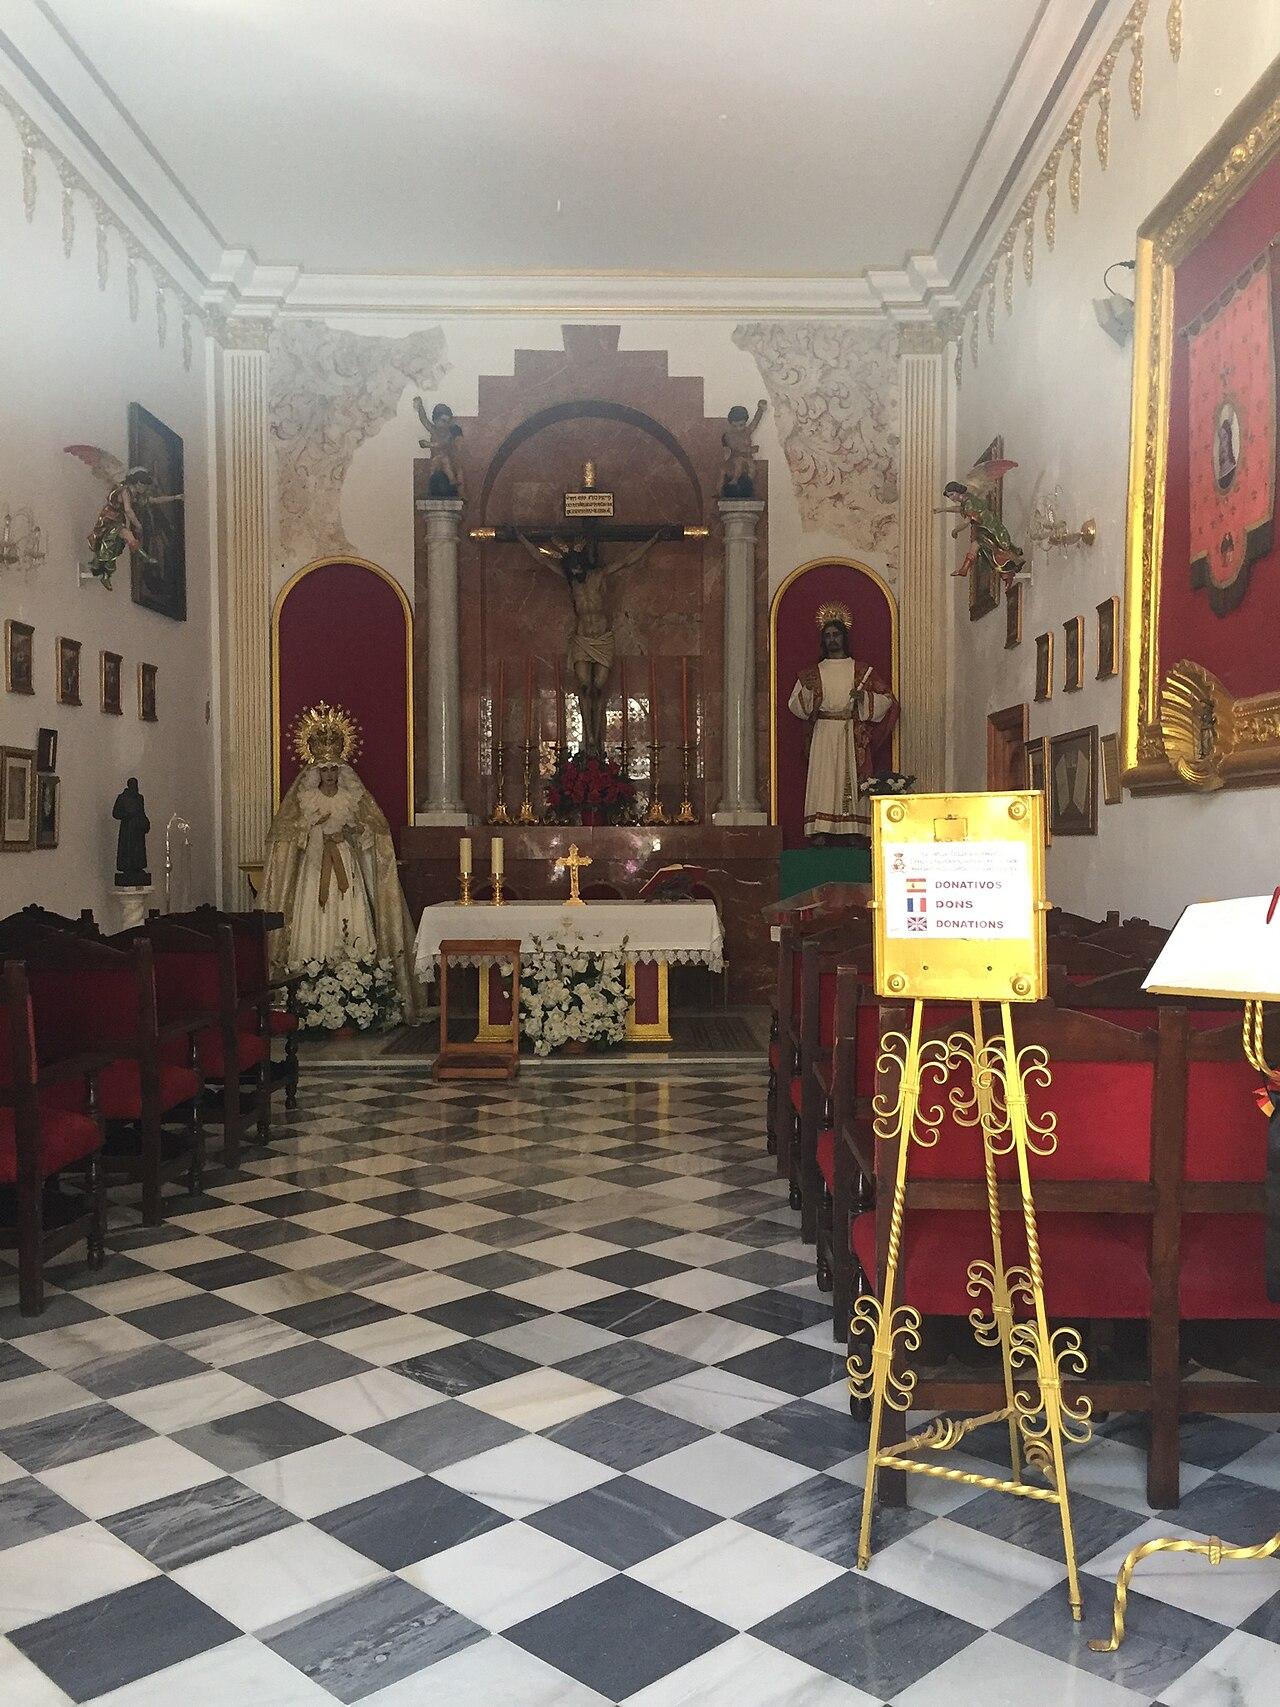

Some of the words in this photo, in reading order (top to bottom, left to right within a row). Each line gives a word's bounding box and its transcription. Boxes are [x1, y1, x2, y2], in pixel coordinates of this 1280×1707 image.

[935, 880, 1003, 890] DONATIVOS
[935, 900, 974, 909] DONS
[936, 919, 1004, 929] DONATIONS
